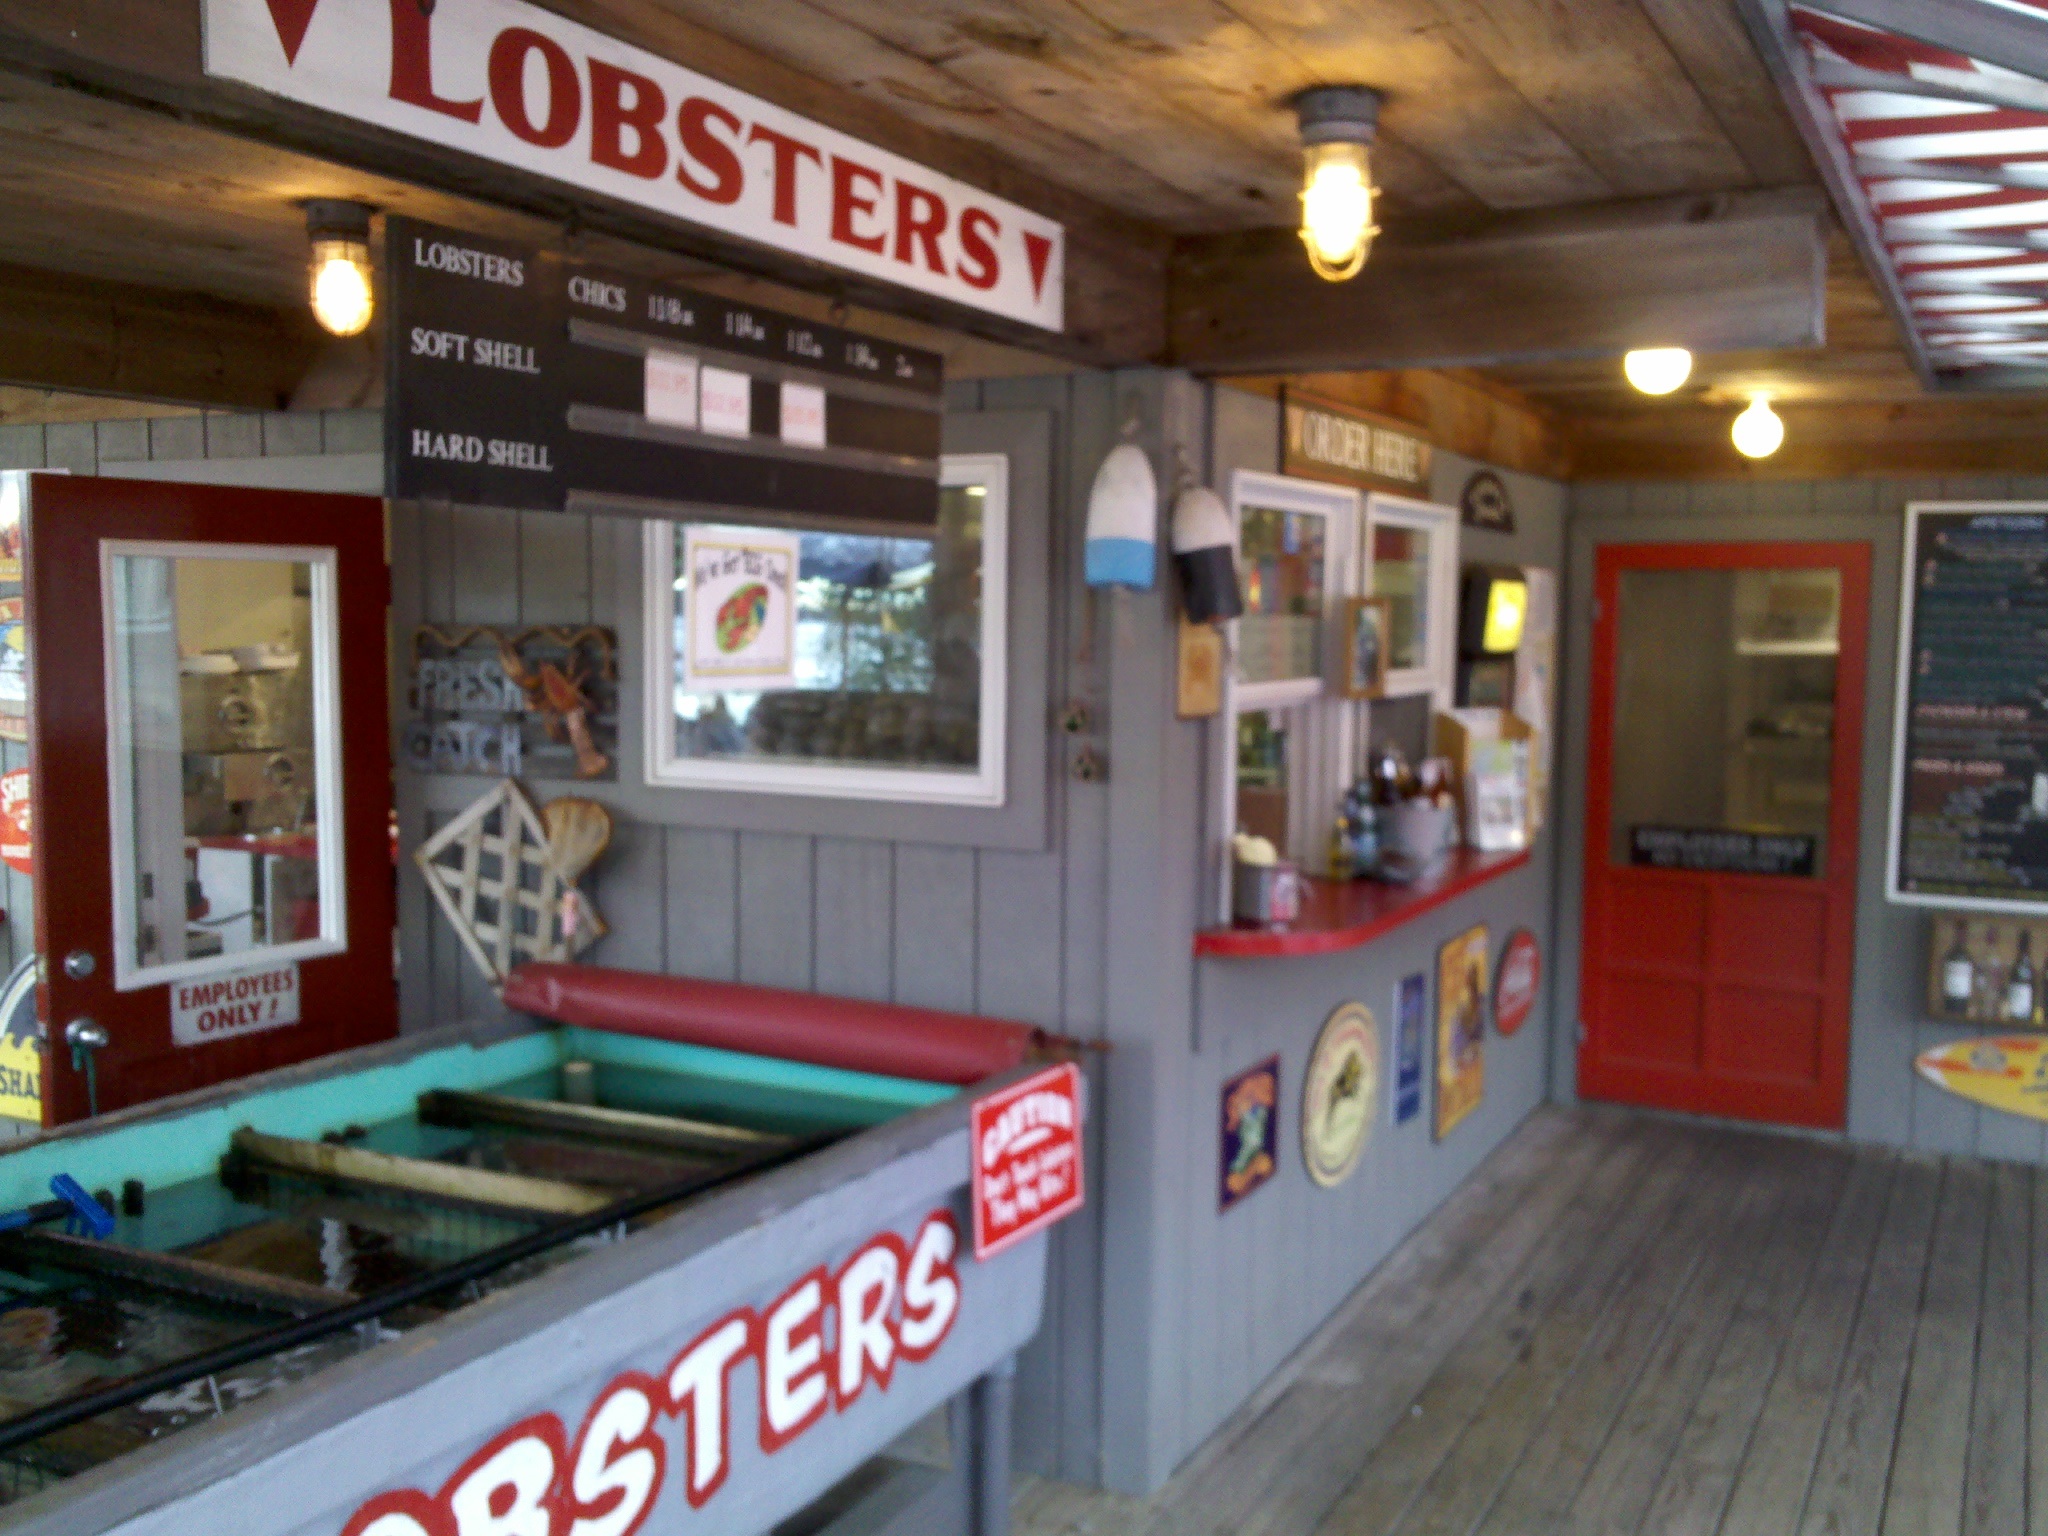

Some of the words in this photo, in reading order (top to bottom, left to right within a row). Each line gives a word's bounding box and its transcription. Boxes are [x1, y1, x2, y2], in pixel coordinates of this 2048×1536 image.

[388, 0, 1001, 292] LOBSTERS
[414, 237, 525, 288] LOBSTERS
[411, 327, 470, 362] SOFT
[473, 338, 542, 375] SHELL
[412, 429, 485, 464] HARD
[487, 438, 554, 473] SHELL
[1303, 410, 1371, 473] ORDER
[1373, 428, 1419, 483] HERE
[179, 968, 294, 1011] EMPLOYEES
[197, 999, 262, 1033] ONLY
[340, 1209, 960, 1536] BSTERS
